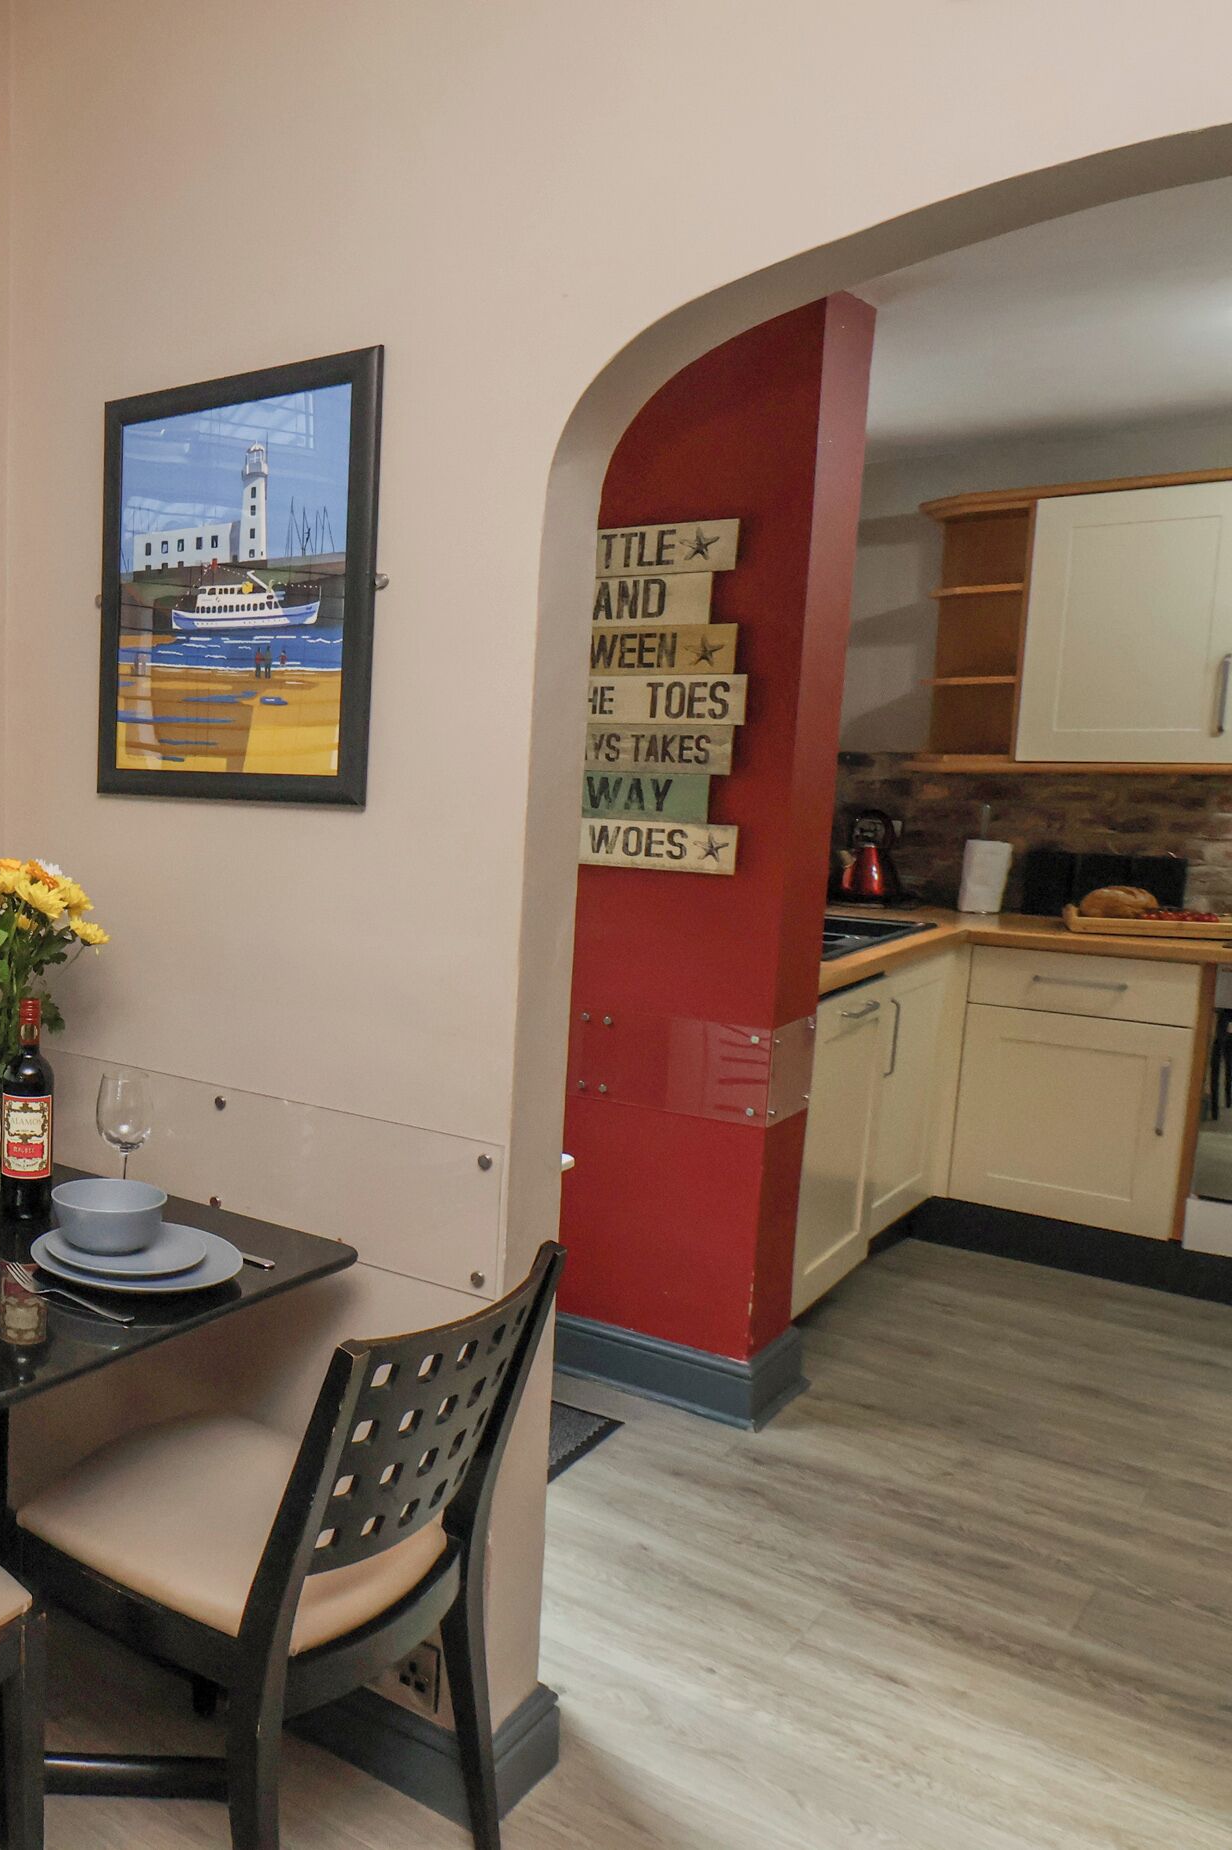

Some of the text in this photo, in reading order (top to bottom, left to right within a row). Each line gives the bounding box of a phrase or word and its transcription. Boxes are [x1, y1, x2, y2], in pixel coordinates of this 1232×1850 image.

[601, 529, 676, 569] TTLE
[592, 578, 667, 620] AND
[590, 632, 677, 669] WEEN
[646, 681, 731, 720] TOES
[631, 733, 712, 765] TAKES
[586, 776, 673, 812] WAY
[588, 825, 689, 860] WOES
